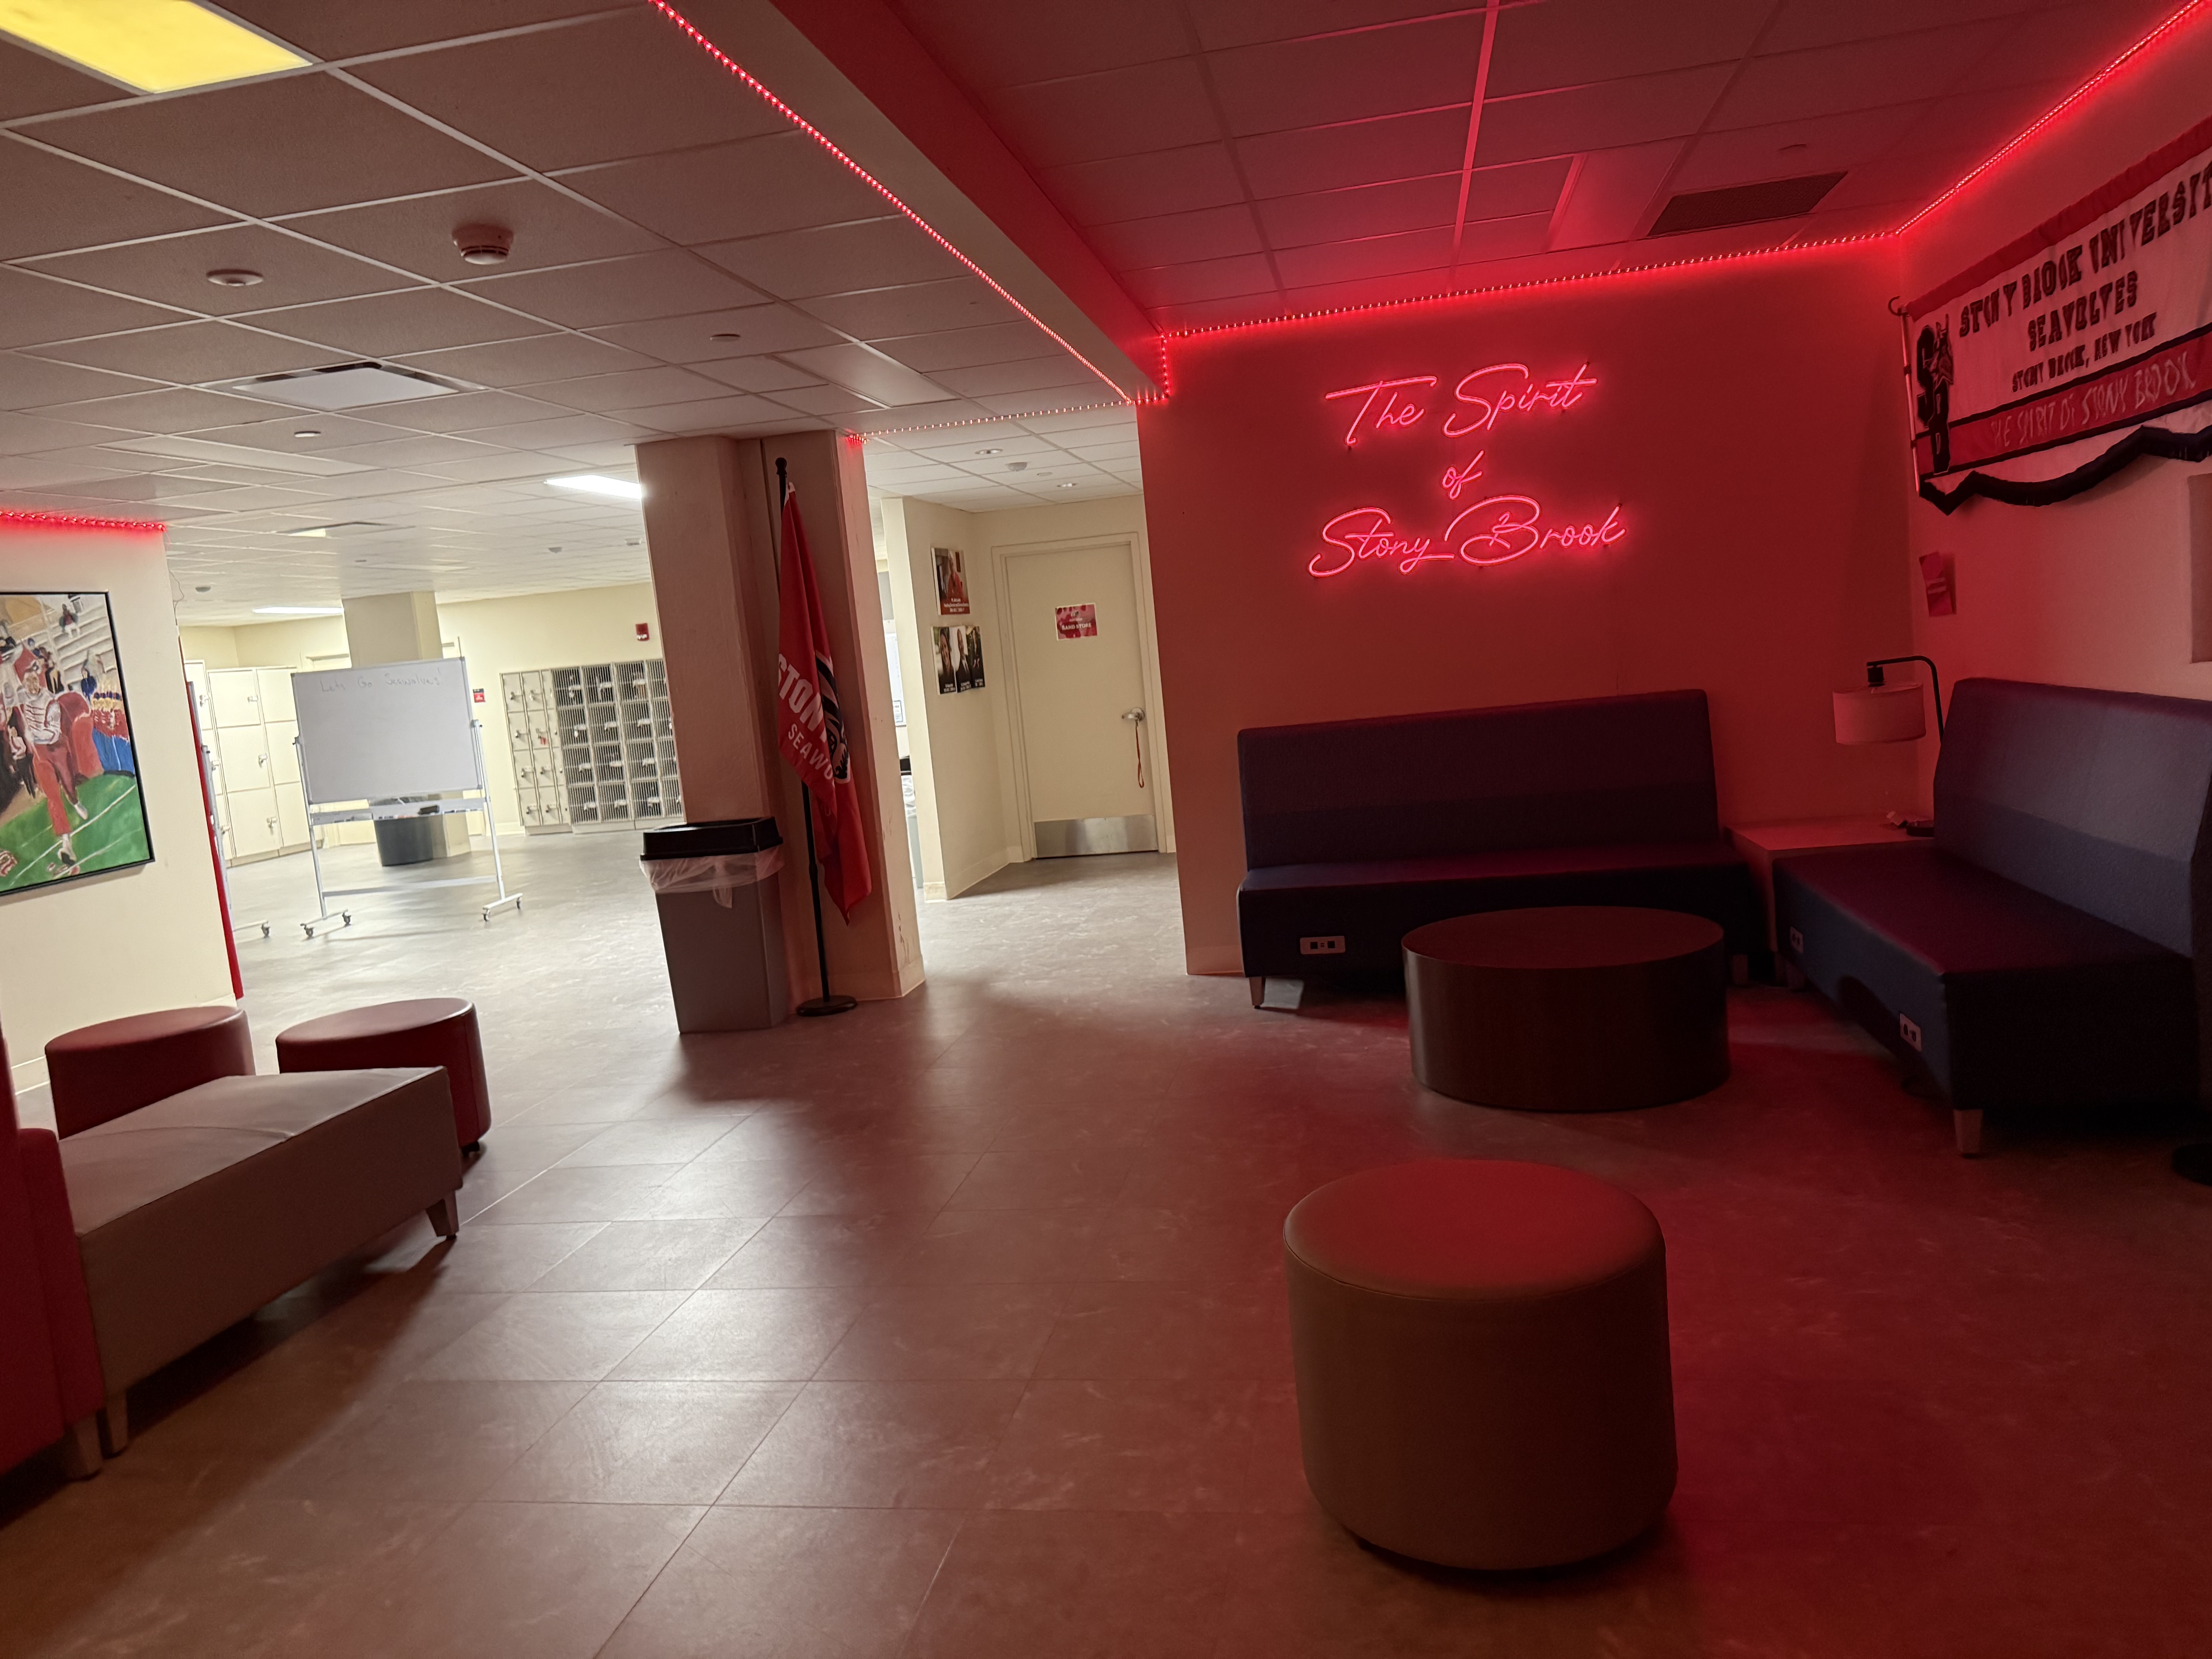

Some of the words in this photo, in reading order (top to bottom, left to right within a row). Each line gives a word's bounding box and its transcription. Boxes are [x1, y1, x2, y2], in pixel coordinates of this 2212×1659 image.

[1325, 375, 1438, 446] The
[1442, 361, 1598, 438] Spirit
[1441, 450, 1484, 500] of
[1308, 507, 1455, 578] Stony
[1444, 494, 1626, 565] Brook
[358, 676, 373, 688] Go
[788, 723, 835, 786] SEAWO
